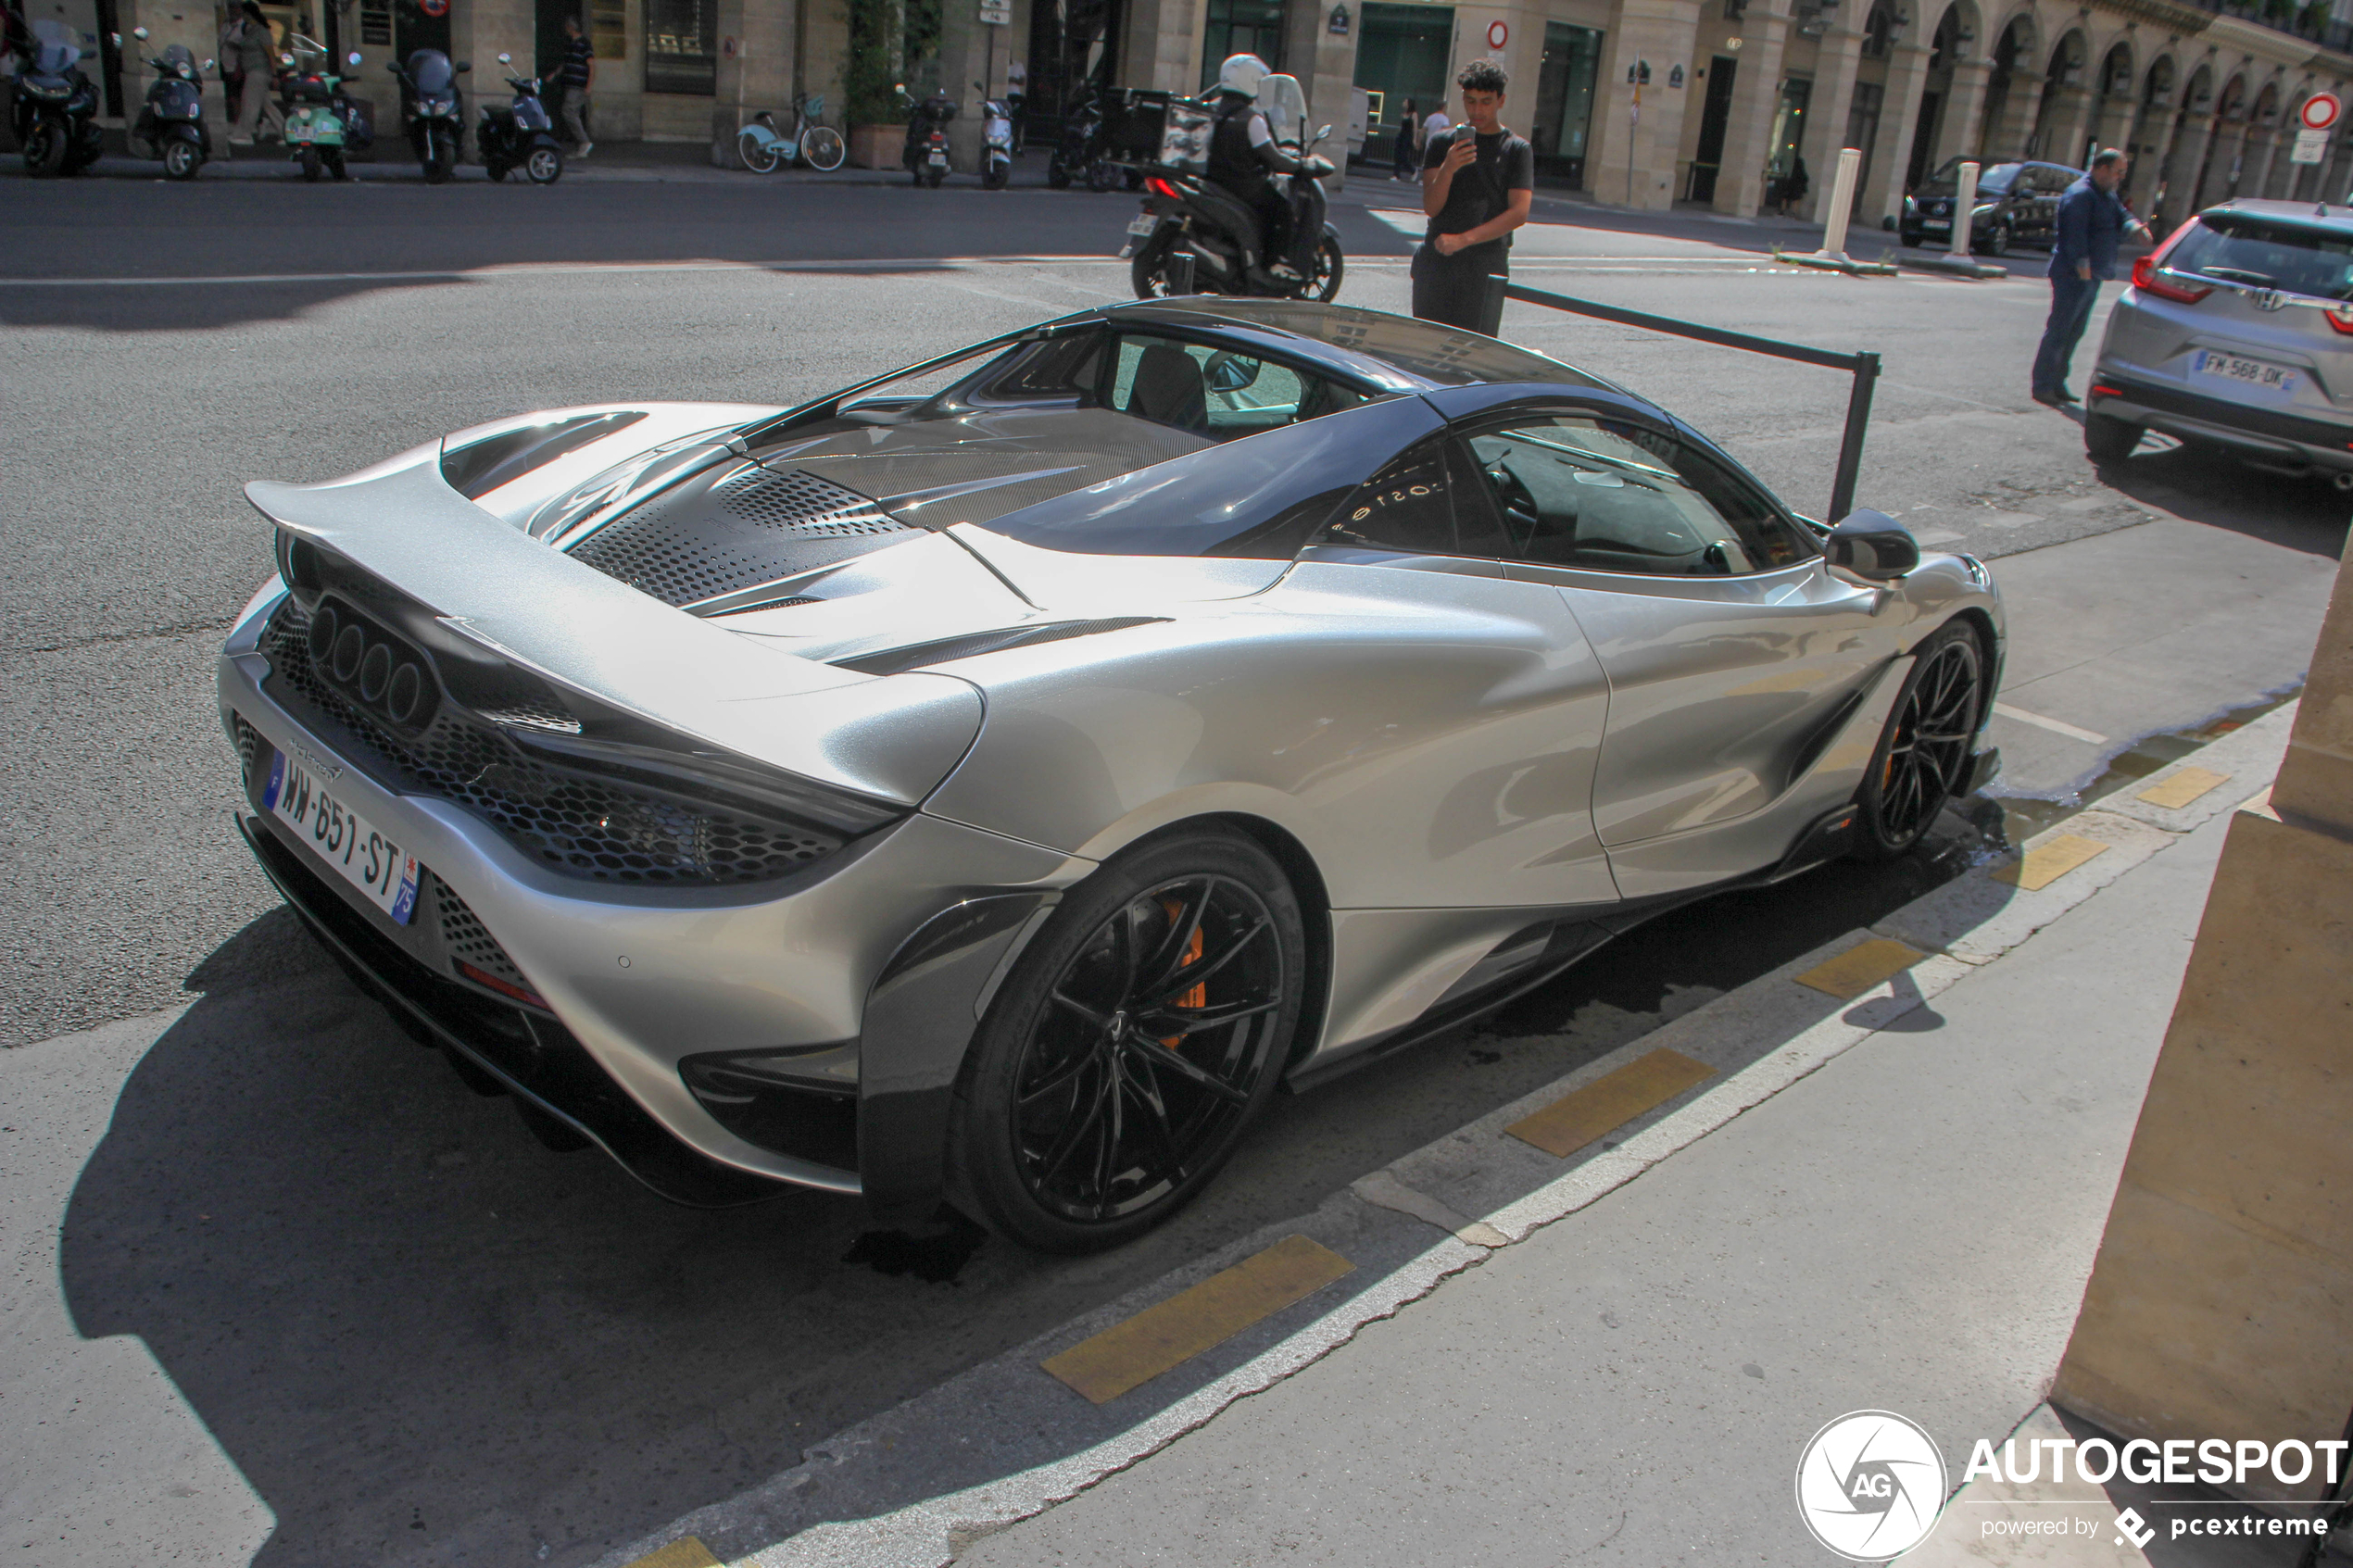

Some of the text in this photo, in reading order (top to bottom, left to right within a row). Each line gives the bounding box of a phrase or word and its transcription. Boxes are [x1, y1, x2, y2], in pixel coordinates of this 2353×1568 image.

[2206, 355, 2286, 385] FM-568-DK
[271, 775, 279, 788] F
[282, 759, 399, 897] WW-651-ST
[396, 882, 414, 913] 75
